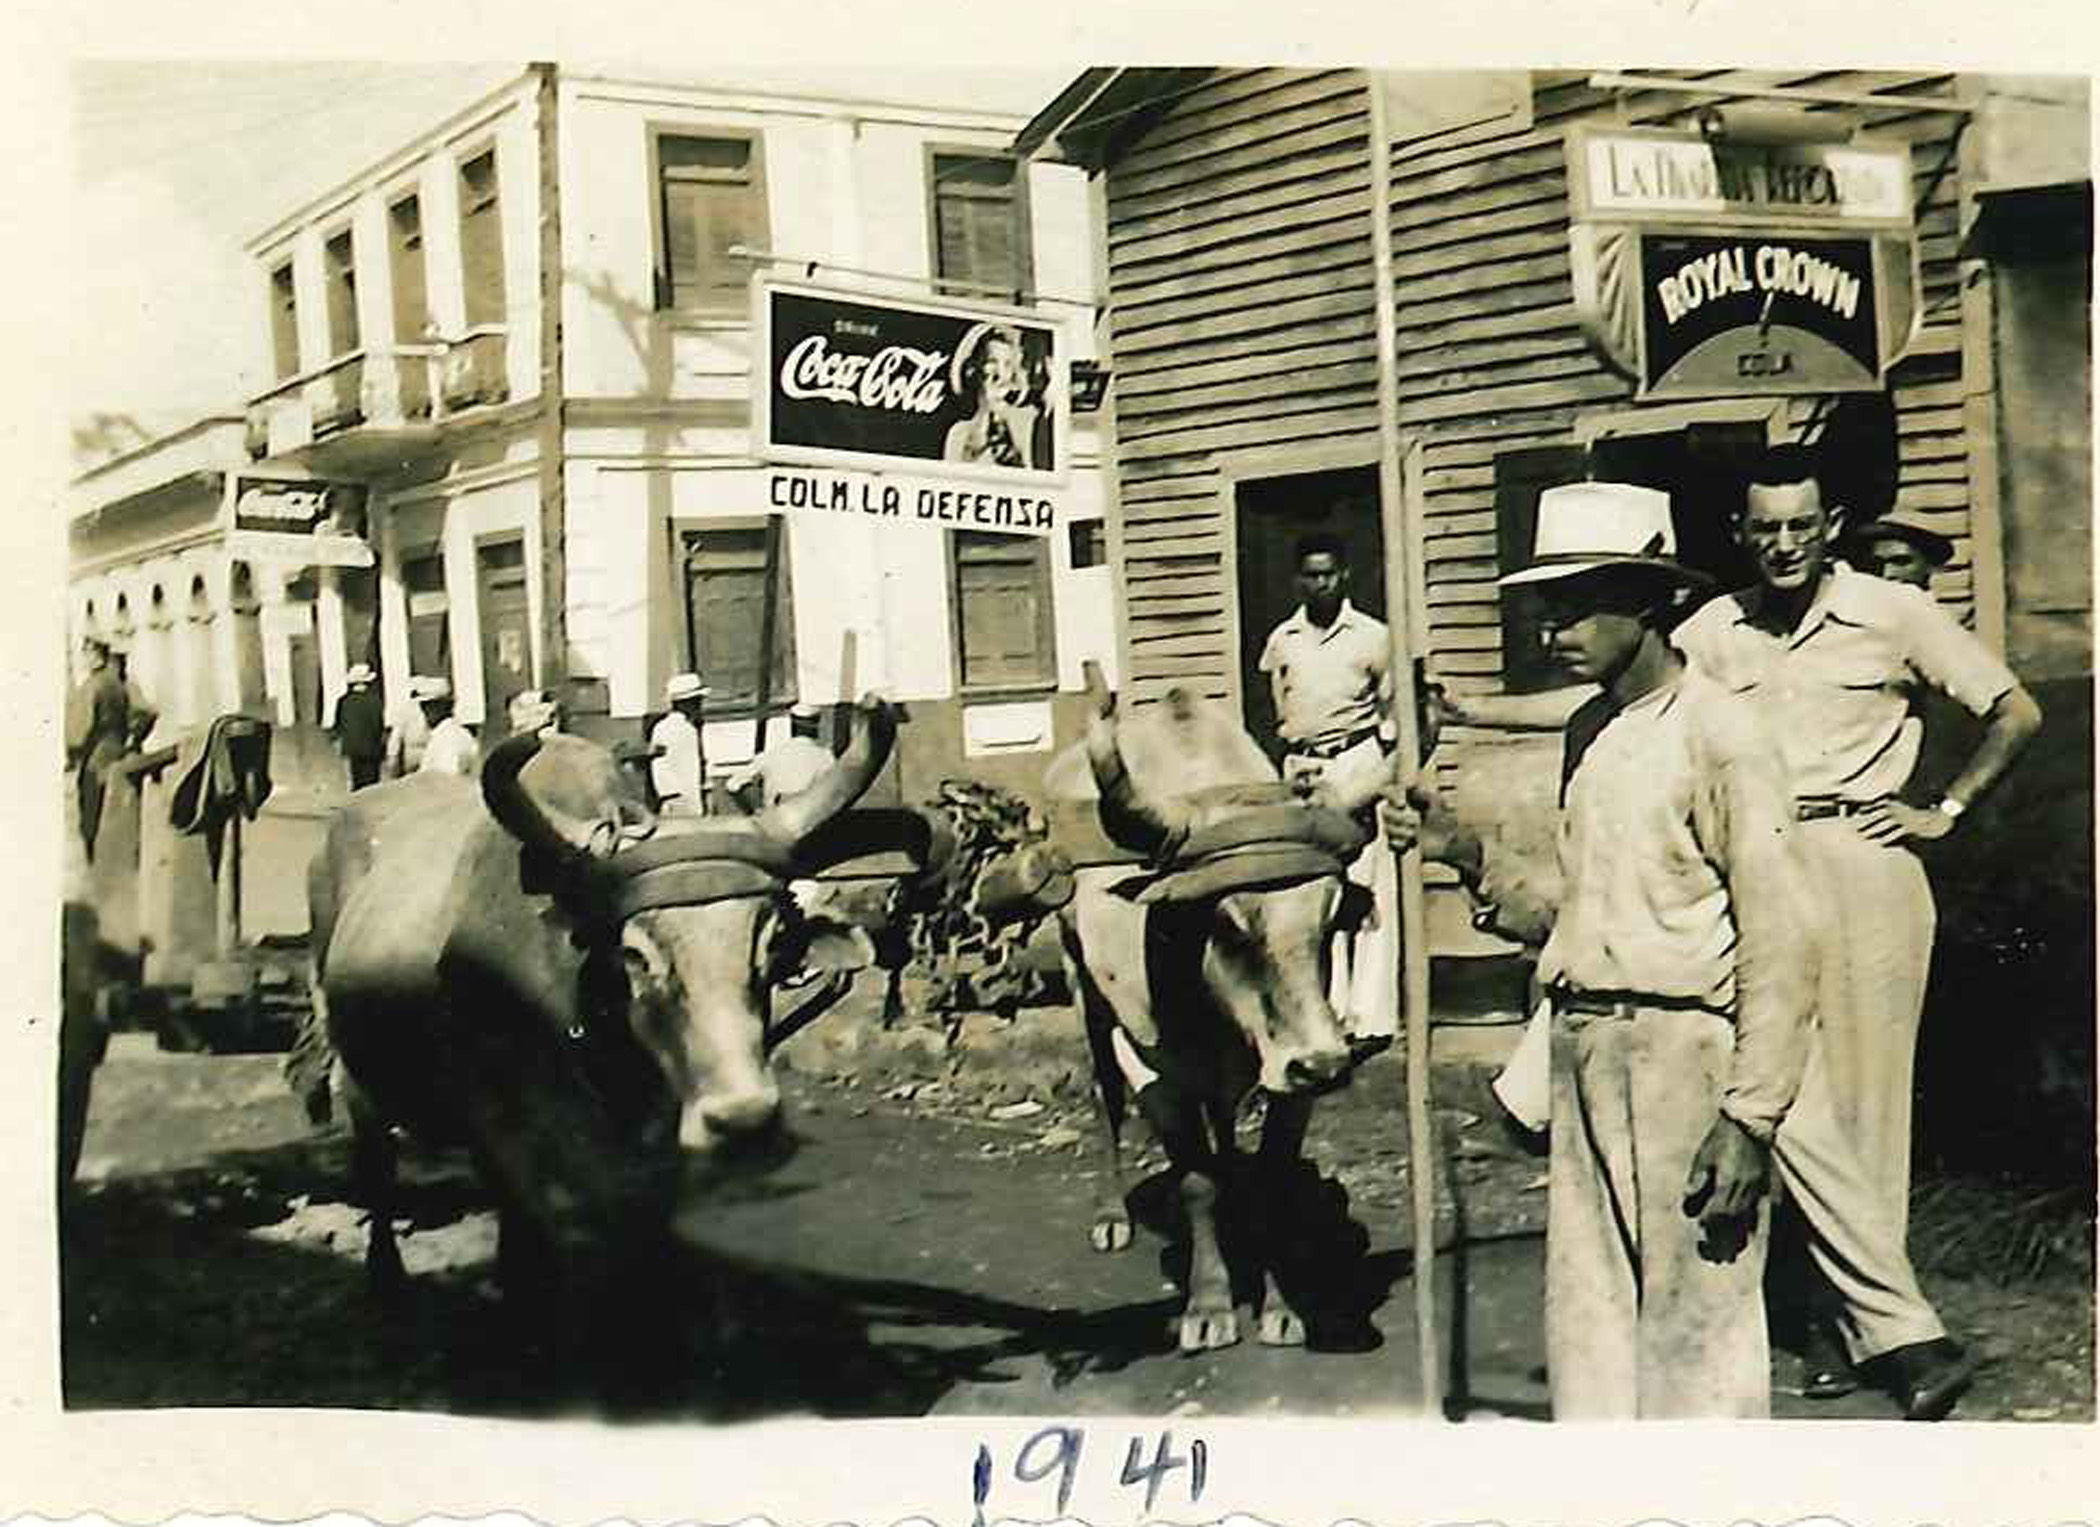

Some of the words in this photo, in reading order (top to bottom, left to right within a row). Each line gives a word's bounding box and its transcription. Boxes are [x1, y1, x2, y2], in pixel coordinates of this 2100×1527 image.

[1657, 247, 1752, 324] ROYAL
[1756, 245, 1860, 320] CROWN
[780, 335, 950, 413] Coca-Cola
[862, 483, 899, 516] LA
[917, 489, 1053, 529] DEFENSA
